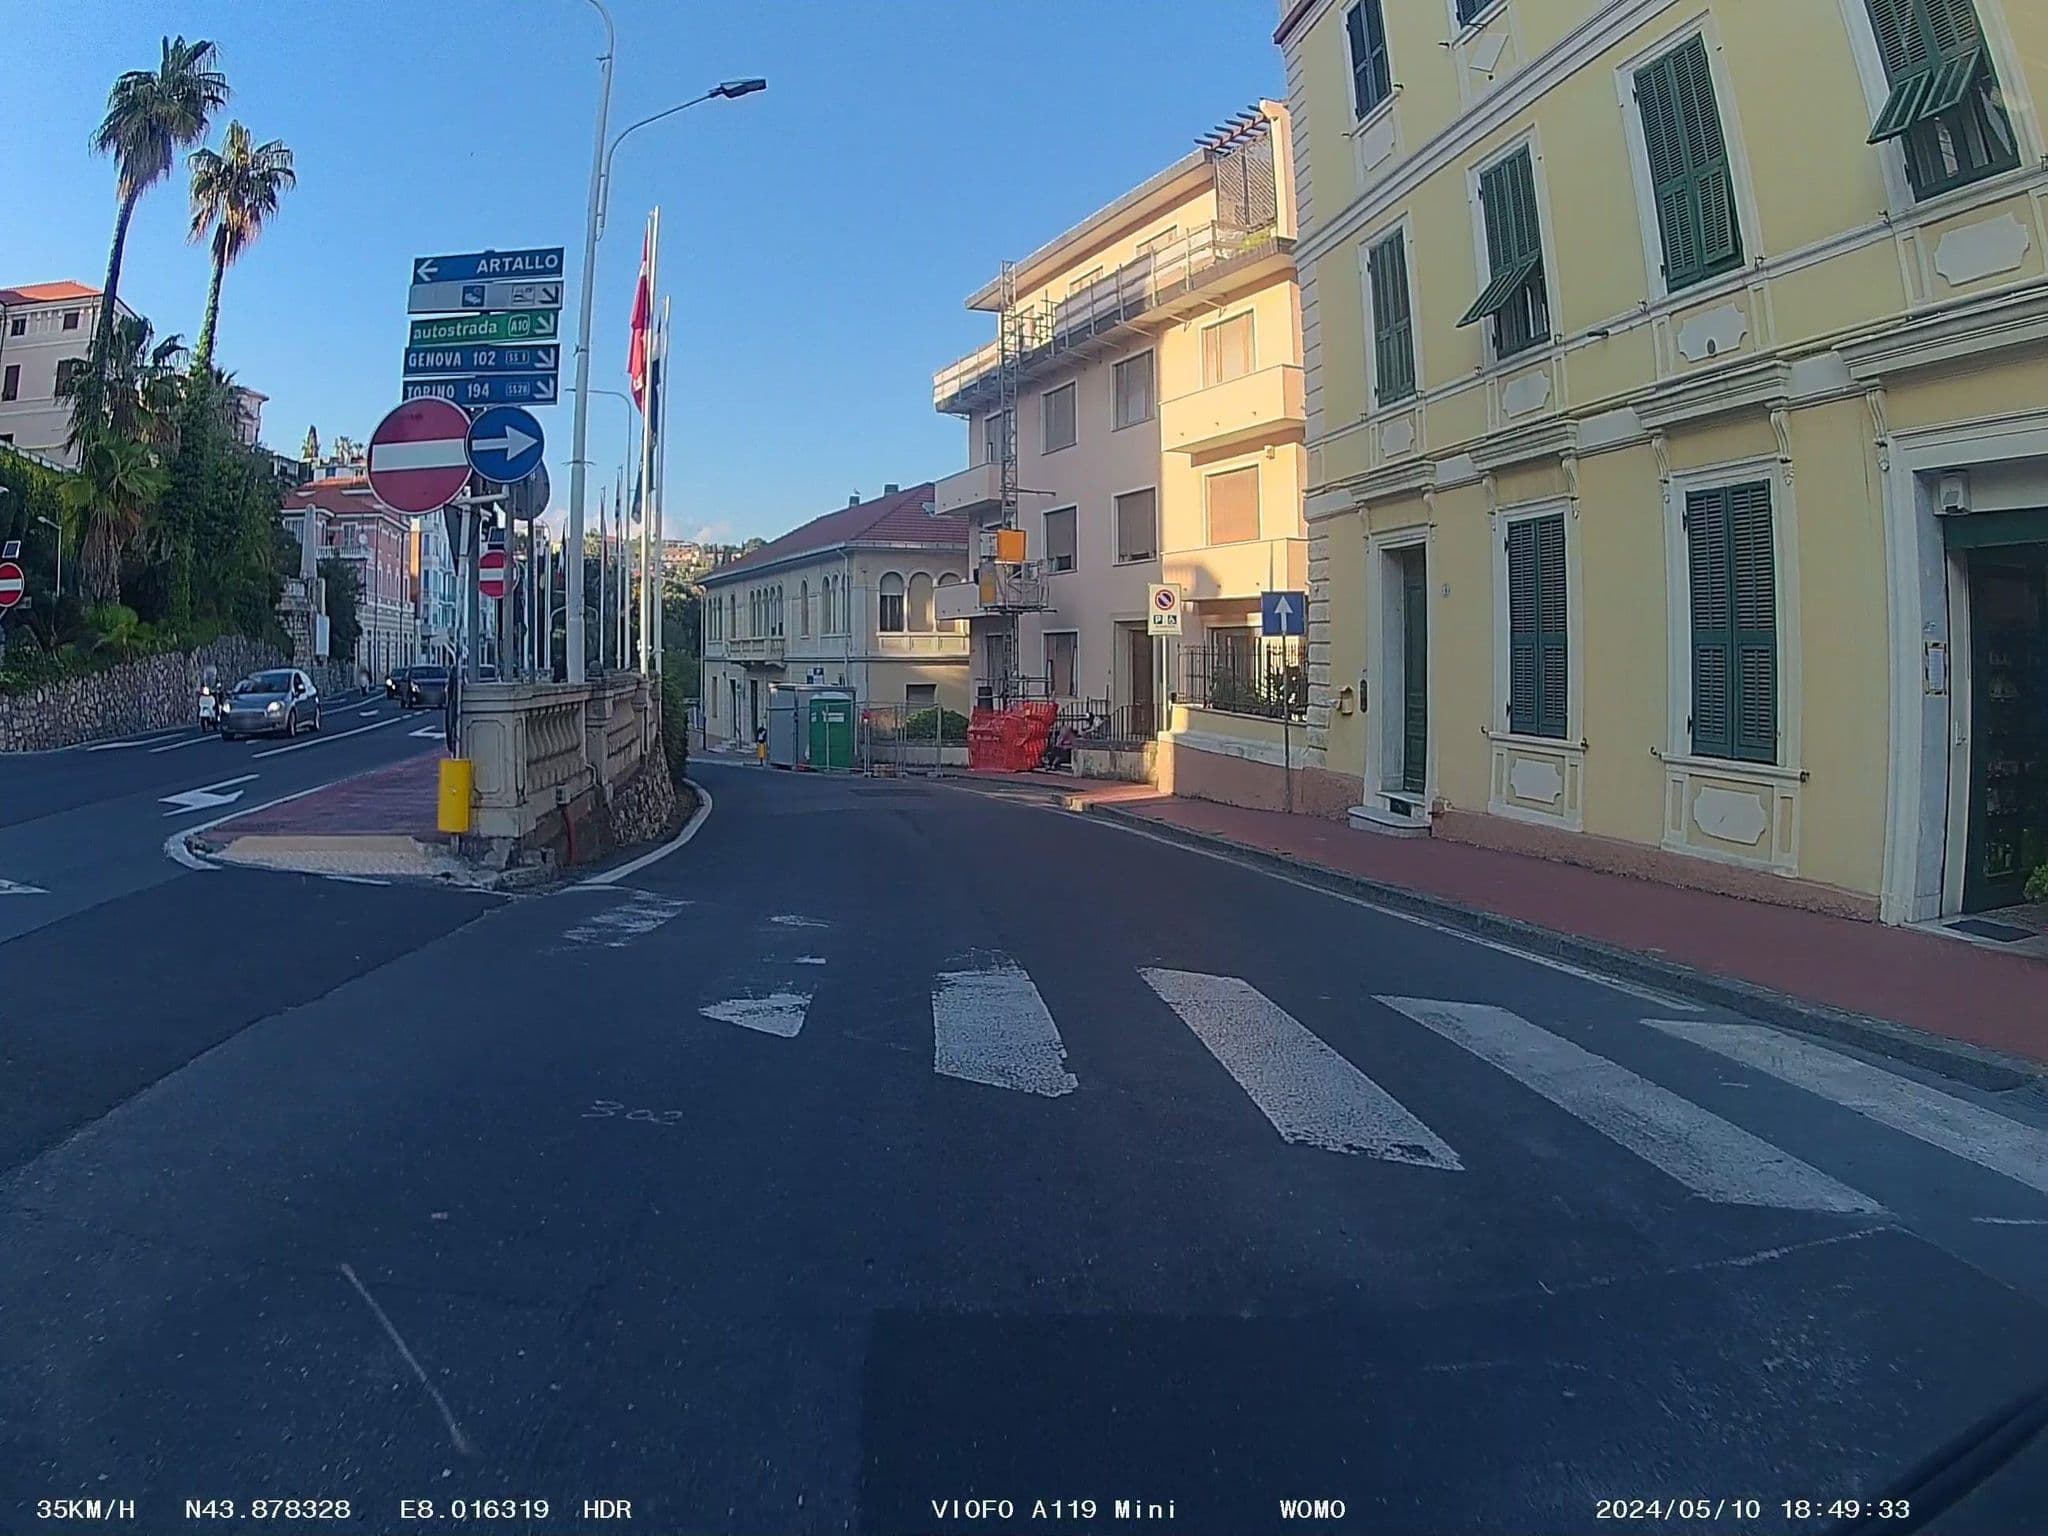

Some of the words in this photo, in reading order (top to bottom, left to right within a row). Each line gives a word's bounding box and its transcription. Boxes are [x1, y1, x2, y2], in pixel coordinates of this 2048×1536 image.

[476, 254, 558, 274] ARTALLO
[413, 320, 498, 340] autostrada
[510, 318, 529, 333] A10
[408, 351, 462, 367] GENOVA
[473, 351, 496, 366] 102
[406, 384, 455, 400] TORINO
[467, 382, 490, 399] 194
